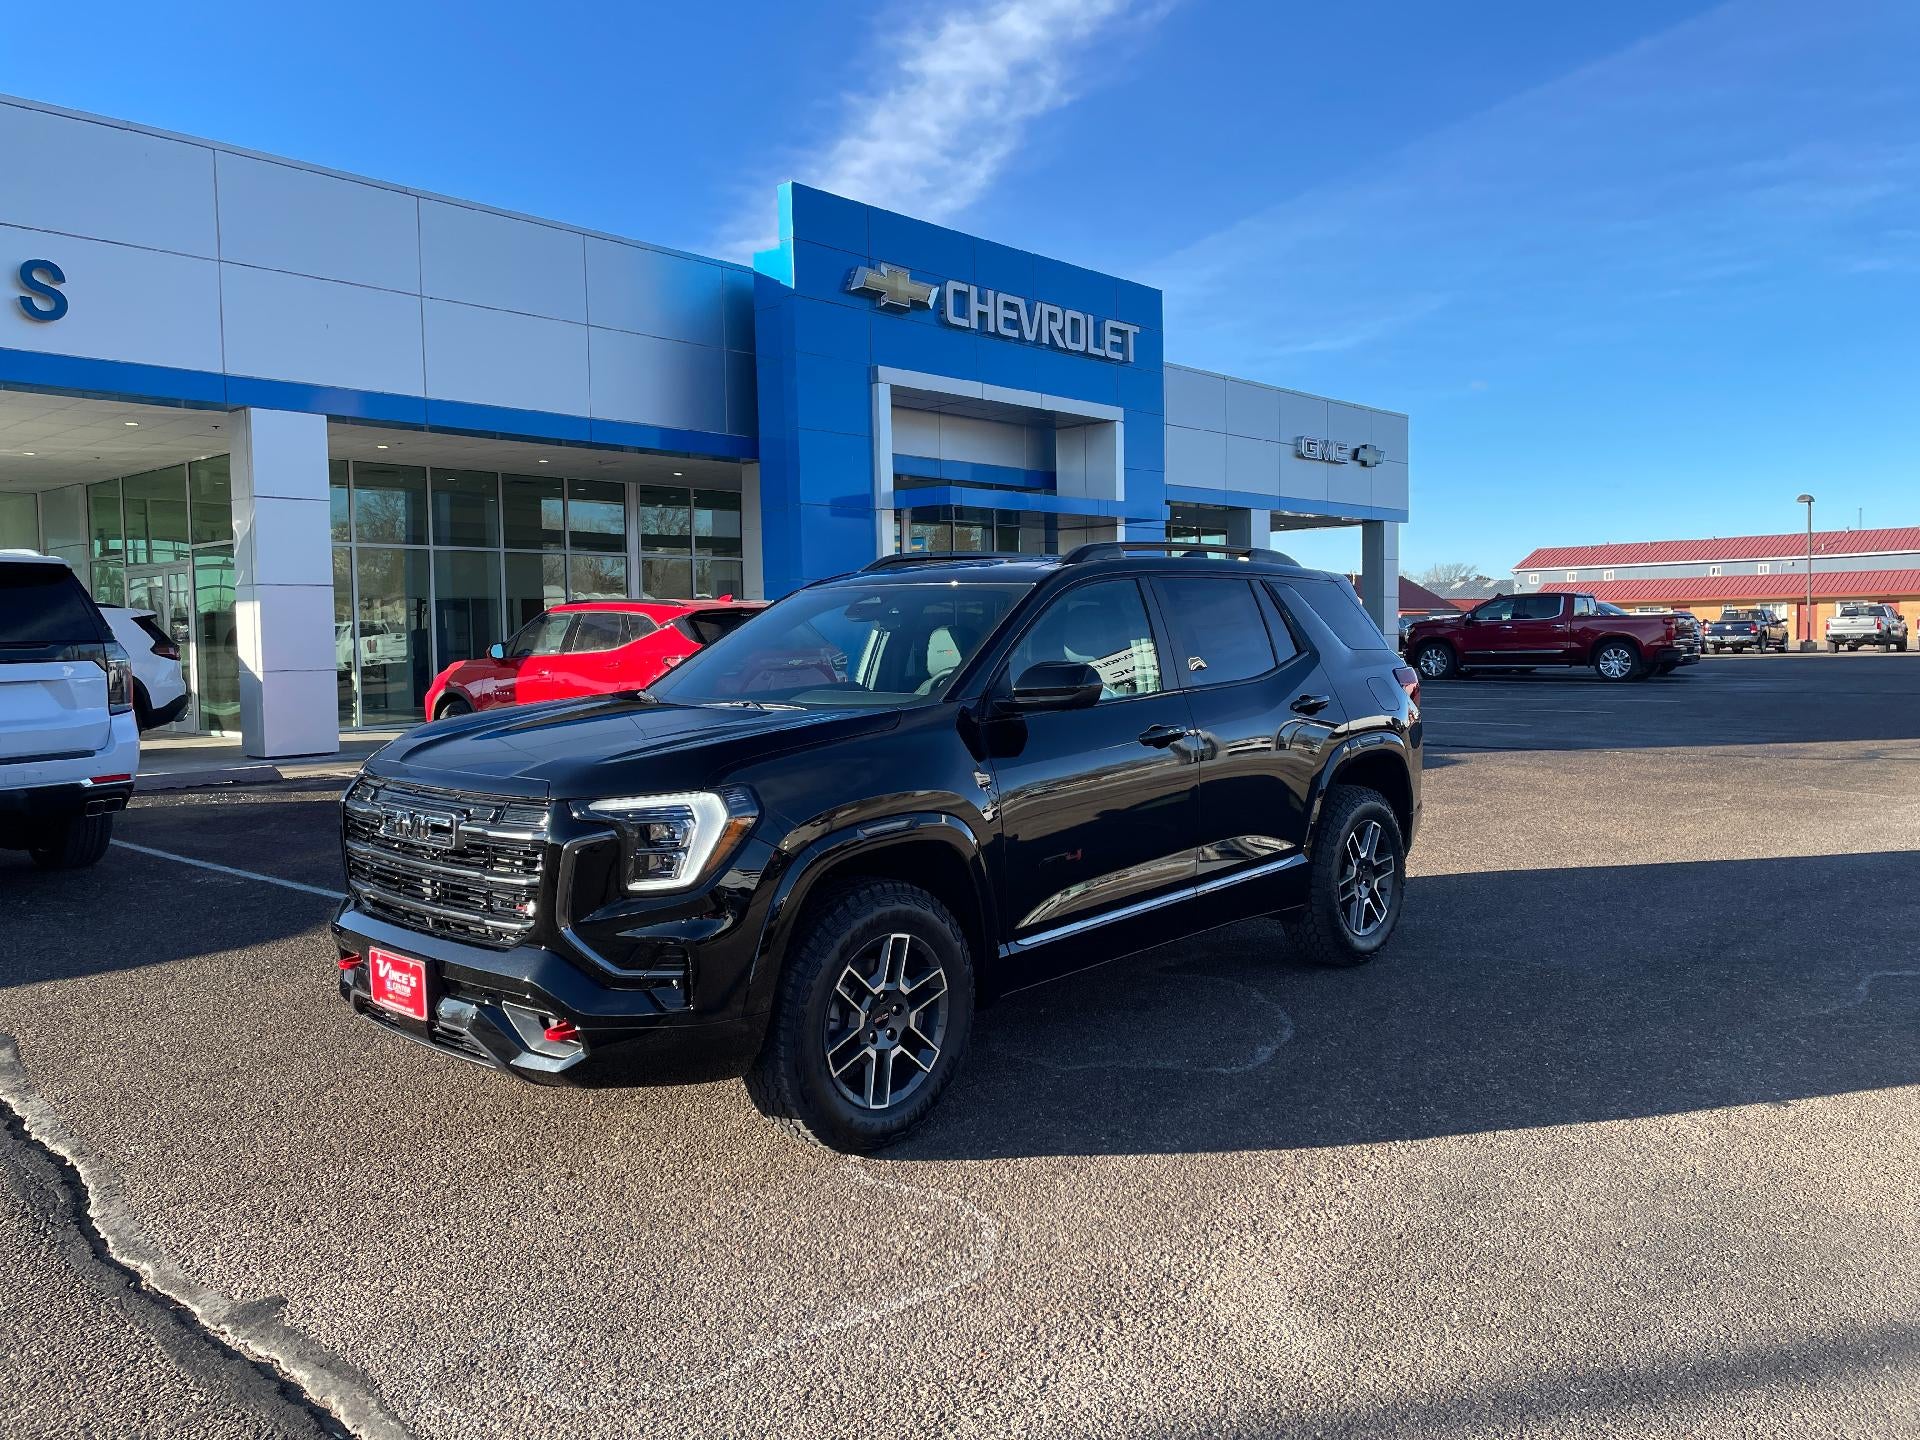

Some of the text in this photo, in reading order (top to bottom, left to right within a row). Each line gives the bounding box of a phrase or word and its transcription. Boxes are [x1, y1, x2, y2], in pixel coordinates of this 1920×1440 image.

[18, 258, 69, 322] S
[945, 279, 1140, 363] CHEVROLET
[1299, 435, 1349, 464] GMC
